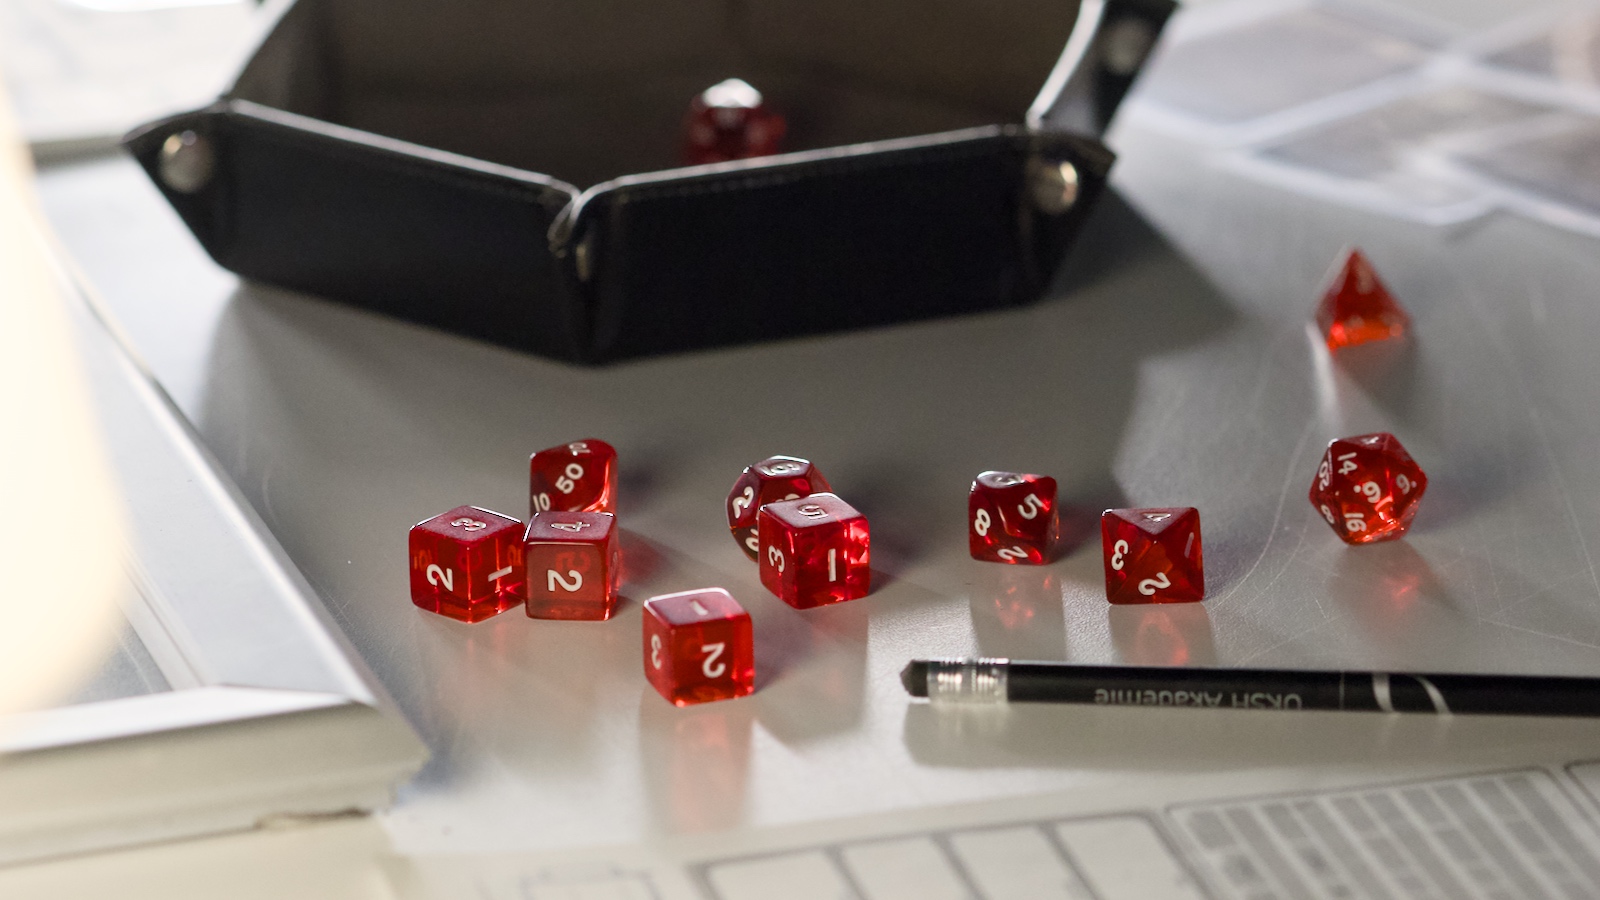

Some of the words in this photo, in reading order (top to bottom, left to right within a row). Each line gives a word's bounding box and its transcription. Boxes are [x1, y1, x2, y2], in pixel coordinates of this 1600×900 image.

[1337, 452, 1358, 475] 14
[555, 463, 584, 494] 50
[532, 492, 551, 512] 10
[732, 486, 754, 519] 2
[798, 504, 829, 520] 5
[1017, 493, 1044, 520] 5
[451, 517, 487, 532] 3
[550, 521, 591, 533] 4
[974, 508, 991, 537] 8
[1344, 513, 1367, 532] 16
[768, 545, 785, 573] 3
[828, 548, 837, 582] 1
[997, 545, 1028, 561] 2
[1111, 539, 1129, 571] 3
[426, 563, 453, 592] 2
[488, 565, 513, 582] 1
[547, 569, 583, 592] 2
[1138, 572, 1171, 596] 2
[651, 634, 662, 670] 3
[701, 642, 726, 679] 2
